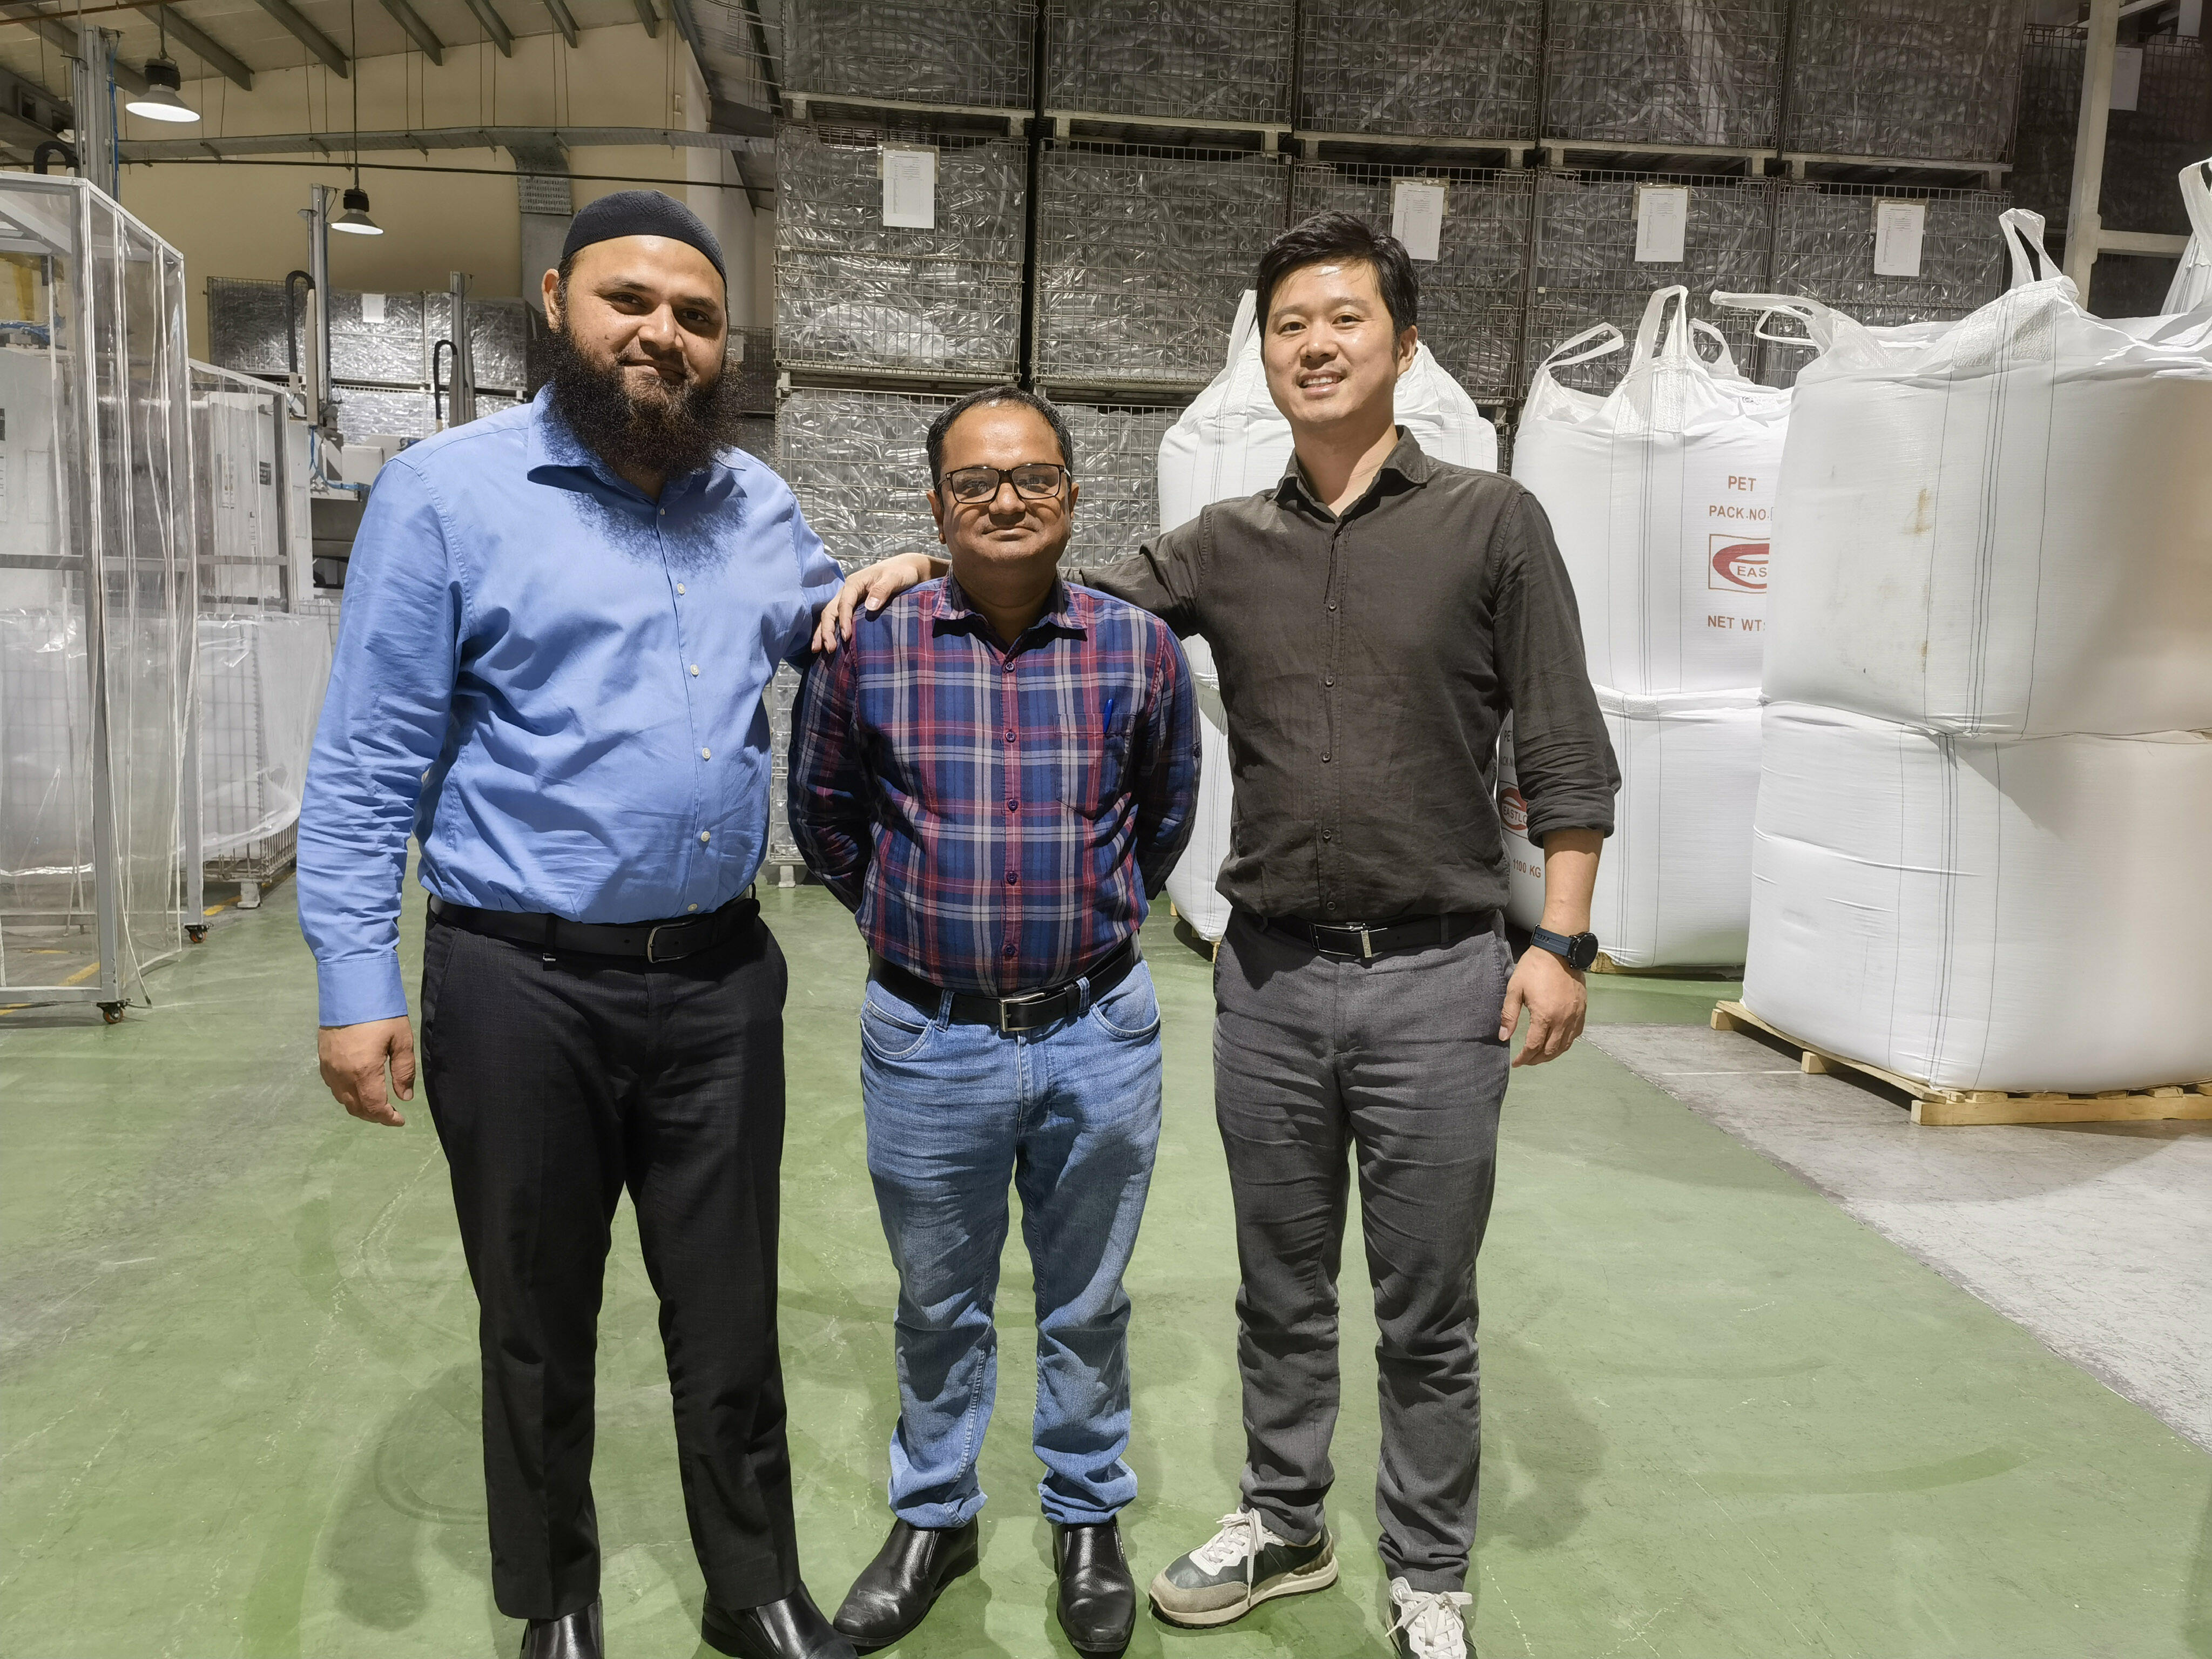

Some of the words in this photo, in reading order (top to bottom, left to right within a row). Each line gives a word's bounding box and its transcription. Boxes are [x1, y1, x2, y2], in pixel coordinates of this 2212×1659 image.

[1728, 475, 1756, 491] PET
[1737, 565, 1768, 577] EAS
[1708, 615, 1735, 629] NET
[1503, 806, 1527, 824] EASTLO
[1513, 858, 1526, 873] 1100
[1529, 865, 1541, 878] KG
